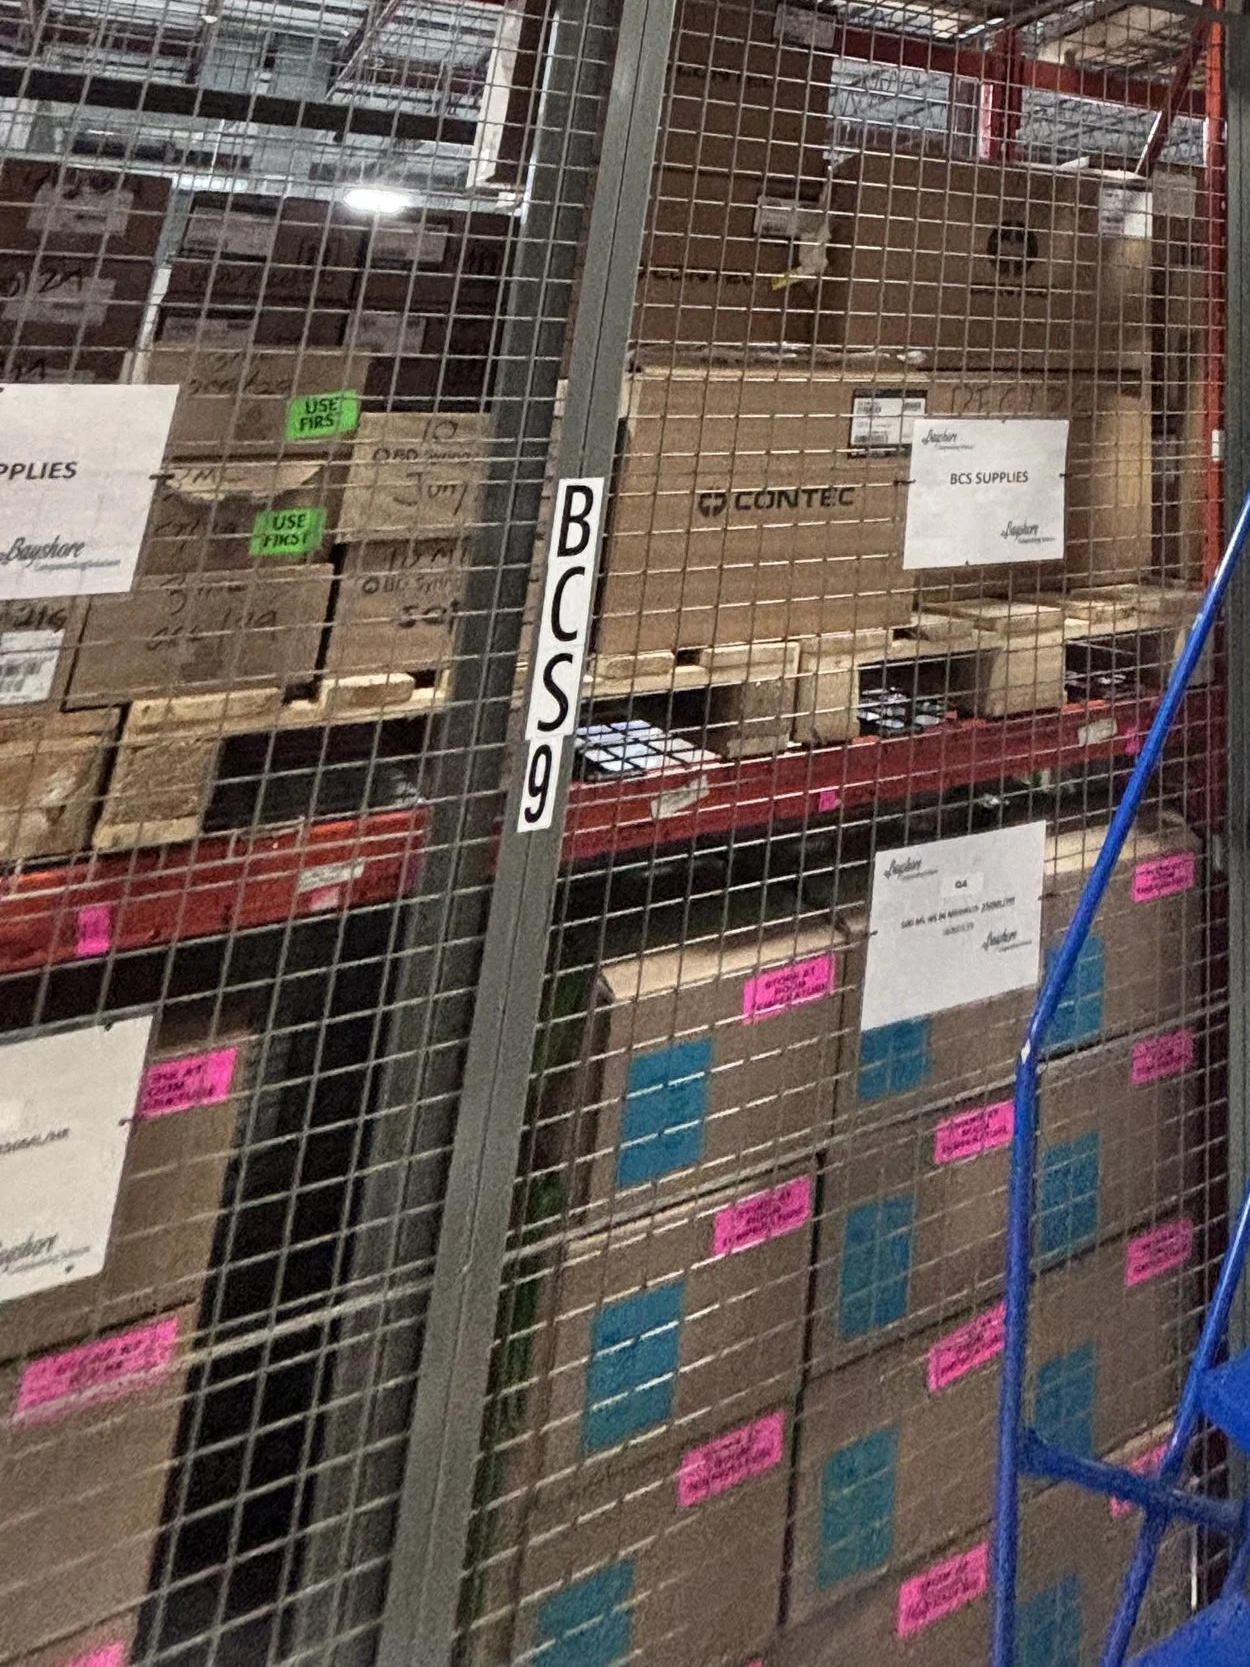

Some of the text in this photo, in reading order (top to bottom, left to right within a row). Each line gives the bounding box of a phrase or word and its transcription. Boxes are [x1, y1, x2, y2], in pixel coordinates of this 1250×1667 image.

[305, 398, 338, 415] USE
[299, 415, 335, 431] FIRS
[950, 470, 1029, 485] BCS SUPPLIES
[735, 486, 855, 511] CONTEC
[272, 513, 307, 529] USE
[524, 743, 552, 824] 9
